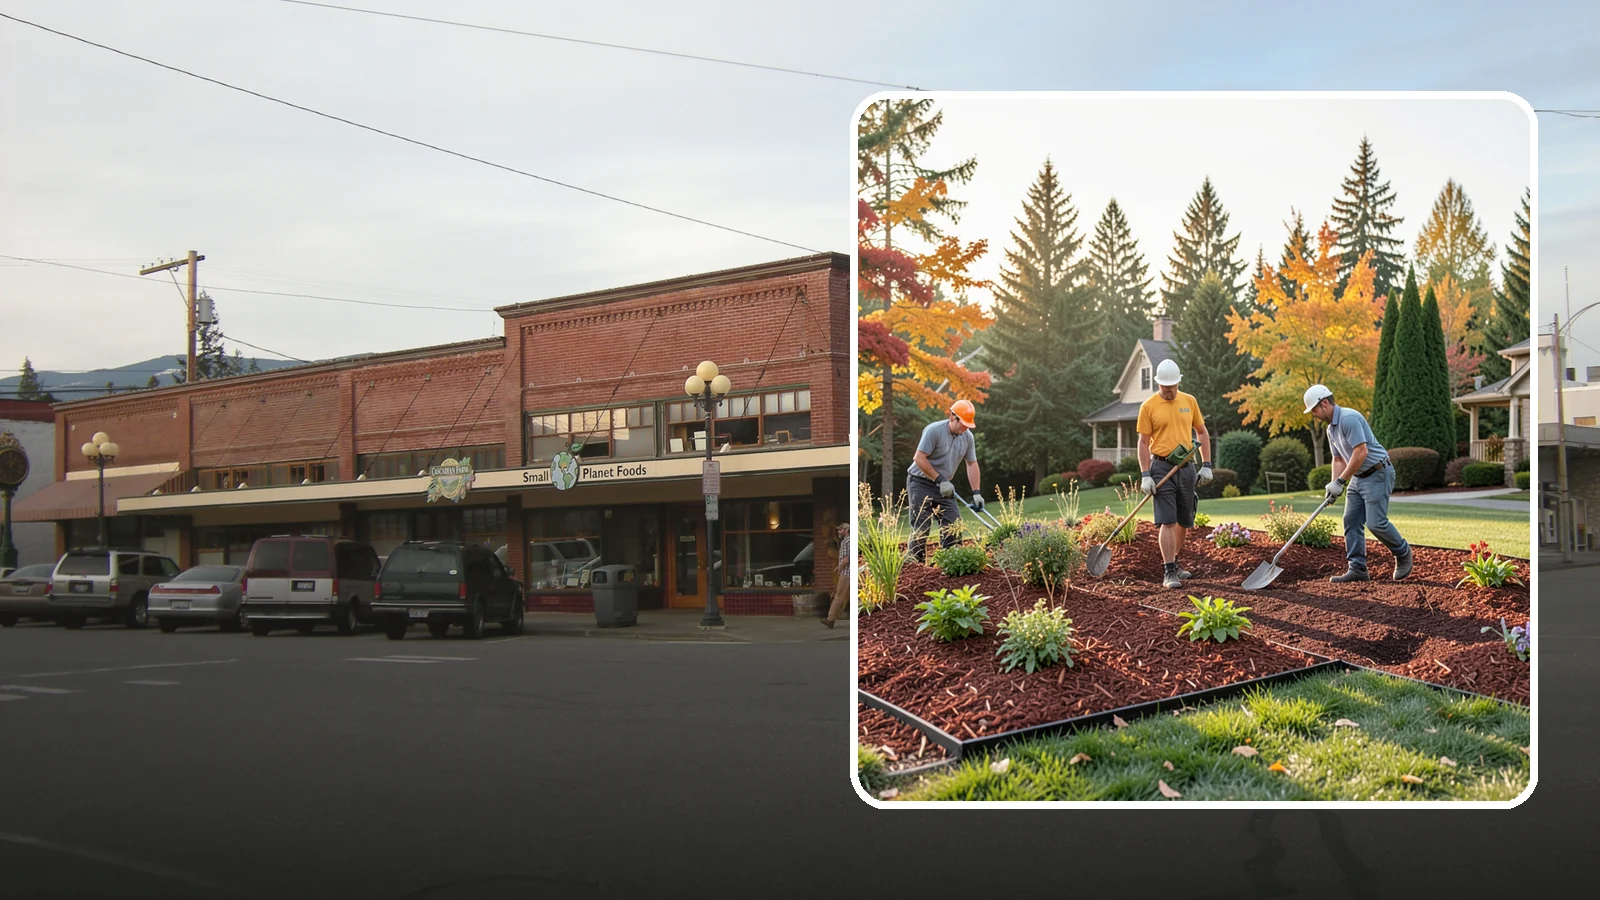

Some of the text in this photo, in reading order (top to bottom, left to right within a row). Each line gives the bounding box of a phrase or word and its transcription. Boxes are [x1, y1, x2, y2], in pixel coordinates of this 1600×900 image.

[523, 464, 647, 483] Small Planet Foods
